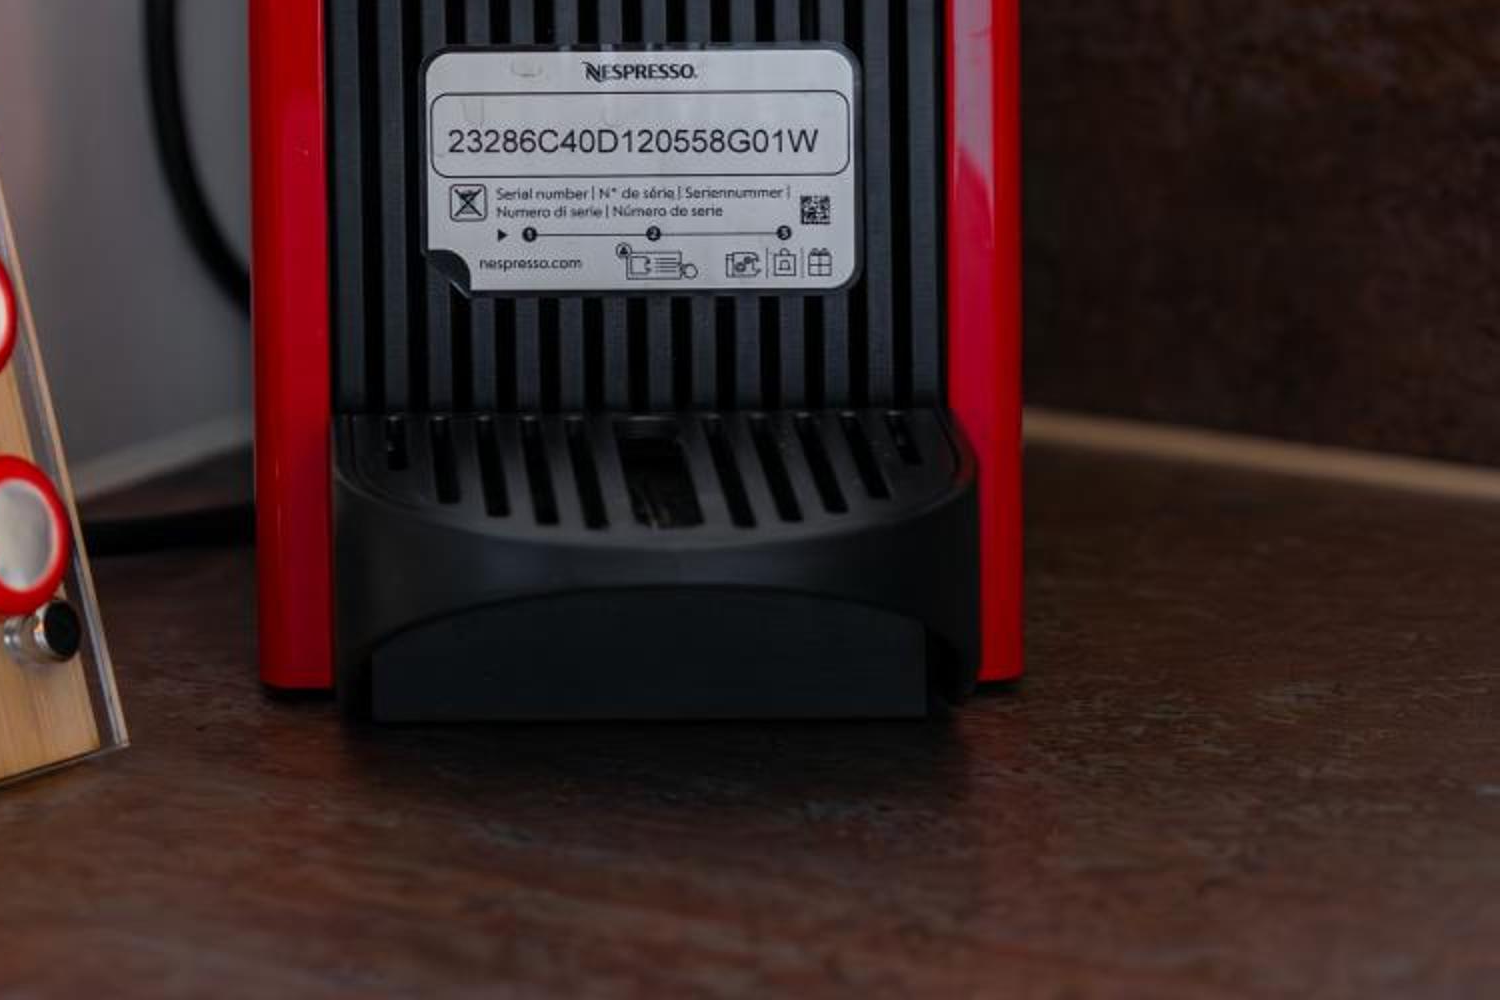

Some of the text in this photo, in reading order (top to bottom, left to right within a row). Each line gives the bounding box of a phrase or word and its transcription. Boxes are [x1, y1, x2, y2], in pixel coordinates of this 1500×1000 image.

[449, 129, 818, 153] 23286C40D120558G01W
[496, 187, 533, 201] Serial
[536, 187, 589, 201] number
[621, 186, 641, 200] de
[685, 186, 784, 200] Seriennummer
[496, 204, 724, 219] Numero di serie Número de serie
[479, 257, 583, 274] nespresso.com
